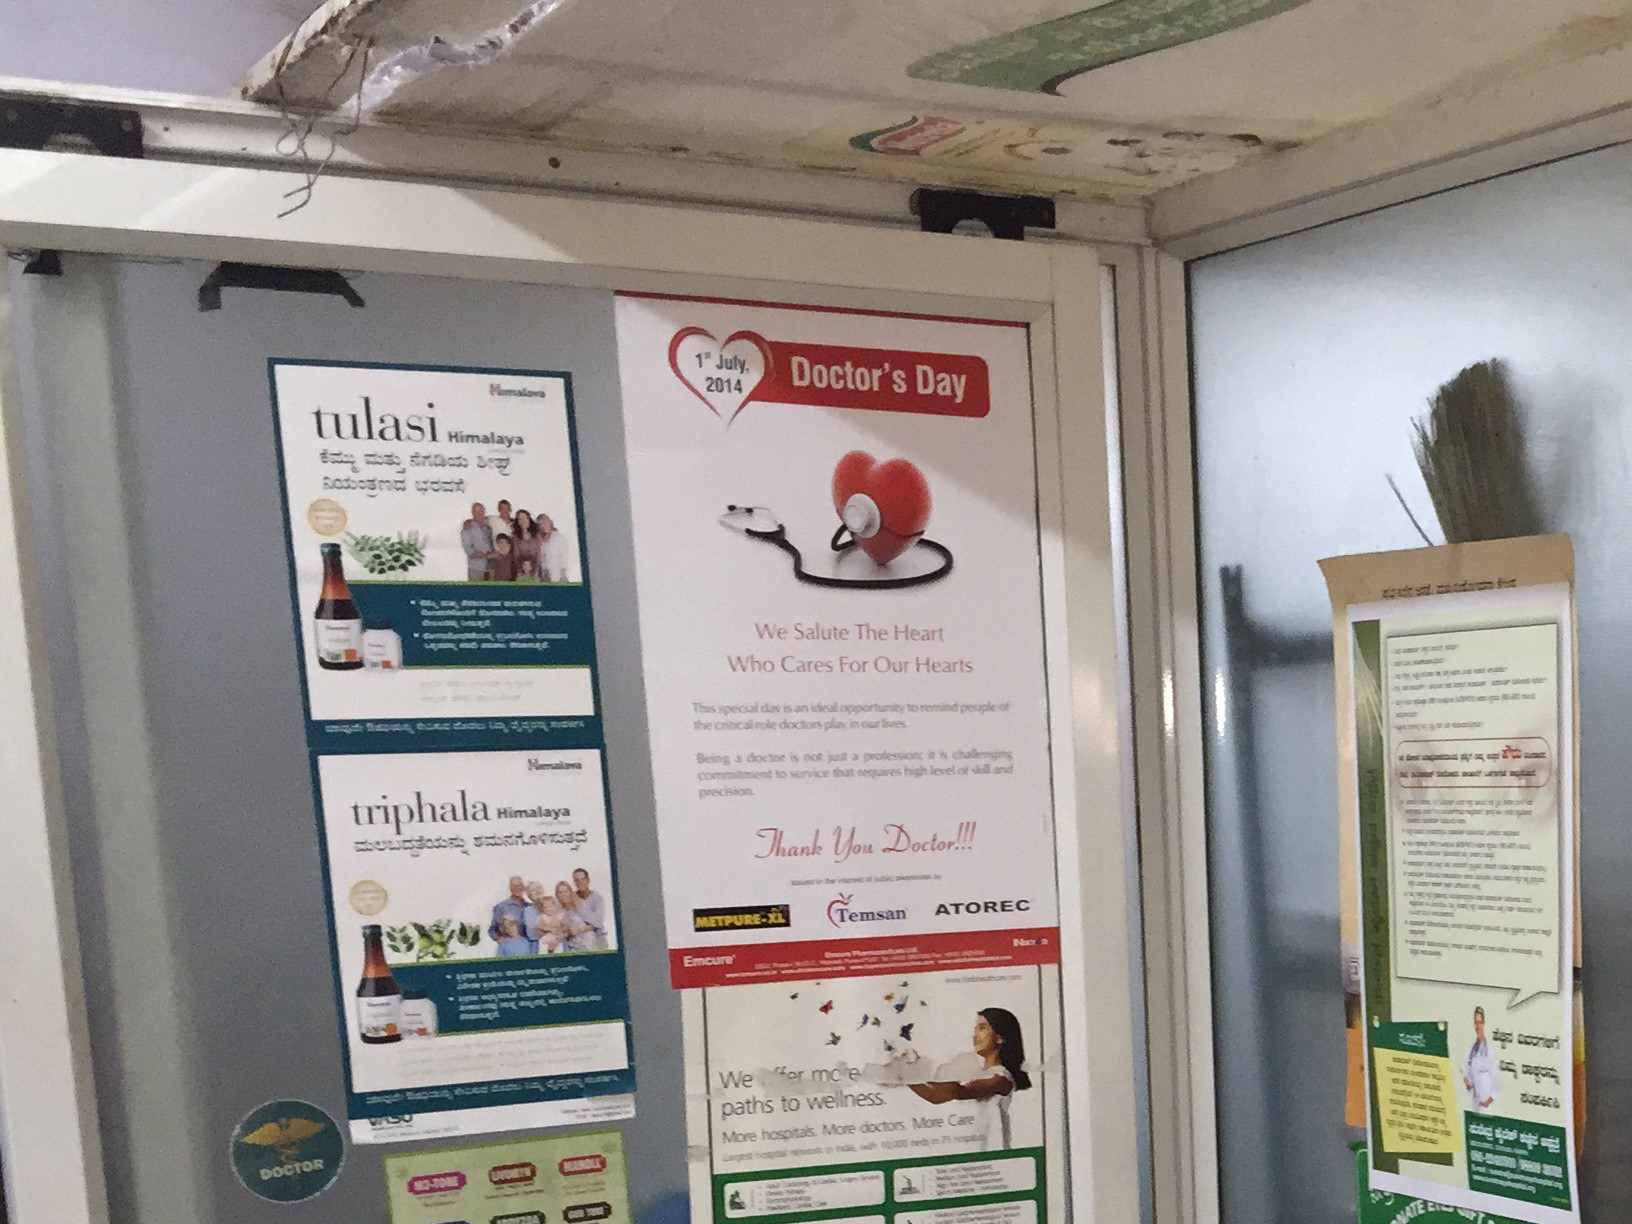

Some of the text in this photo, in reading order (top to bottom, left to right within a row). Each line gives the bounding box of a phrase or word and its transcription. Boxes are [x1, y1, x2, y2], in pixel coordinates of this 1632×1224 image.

[715, 354, 750, 374] July,
[705, 377, 743, 395] 2014
[790, 356, 967, 404] Doctor's Day
[312, 396, 439, 443] tulasi
[448, 430, 524, 448] Himalaya
[754, 623, 944, 643] We Salute The Heart
[727, 656, 973, 674] Who Cares For Our Hearts
[351, 789, 491, 835] triphala
[496, 806, 571, 821] Himalaya
[755, 821, 977, 863] Thank You Doctor!!!
[695, 908, 787, 928] METPURE-XL
[836, 907, 907, 923] Temsan
[935, 899, 1031, 917] ATOREC
[719, 1070, 753, 1089] We
[721, 1090, 888, 1121] paths to wellness.
[722, 1130, 757, 1144] More
[761, 1125, 818, 1142] hospitals.
[822, 1123, 857, 1136] More
[911, 1115, 943, 1130] More
[946, 1113, 975, 1128] Care
[259, 1158, 324, 1181] DOCTOR
